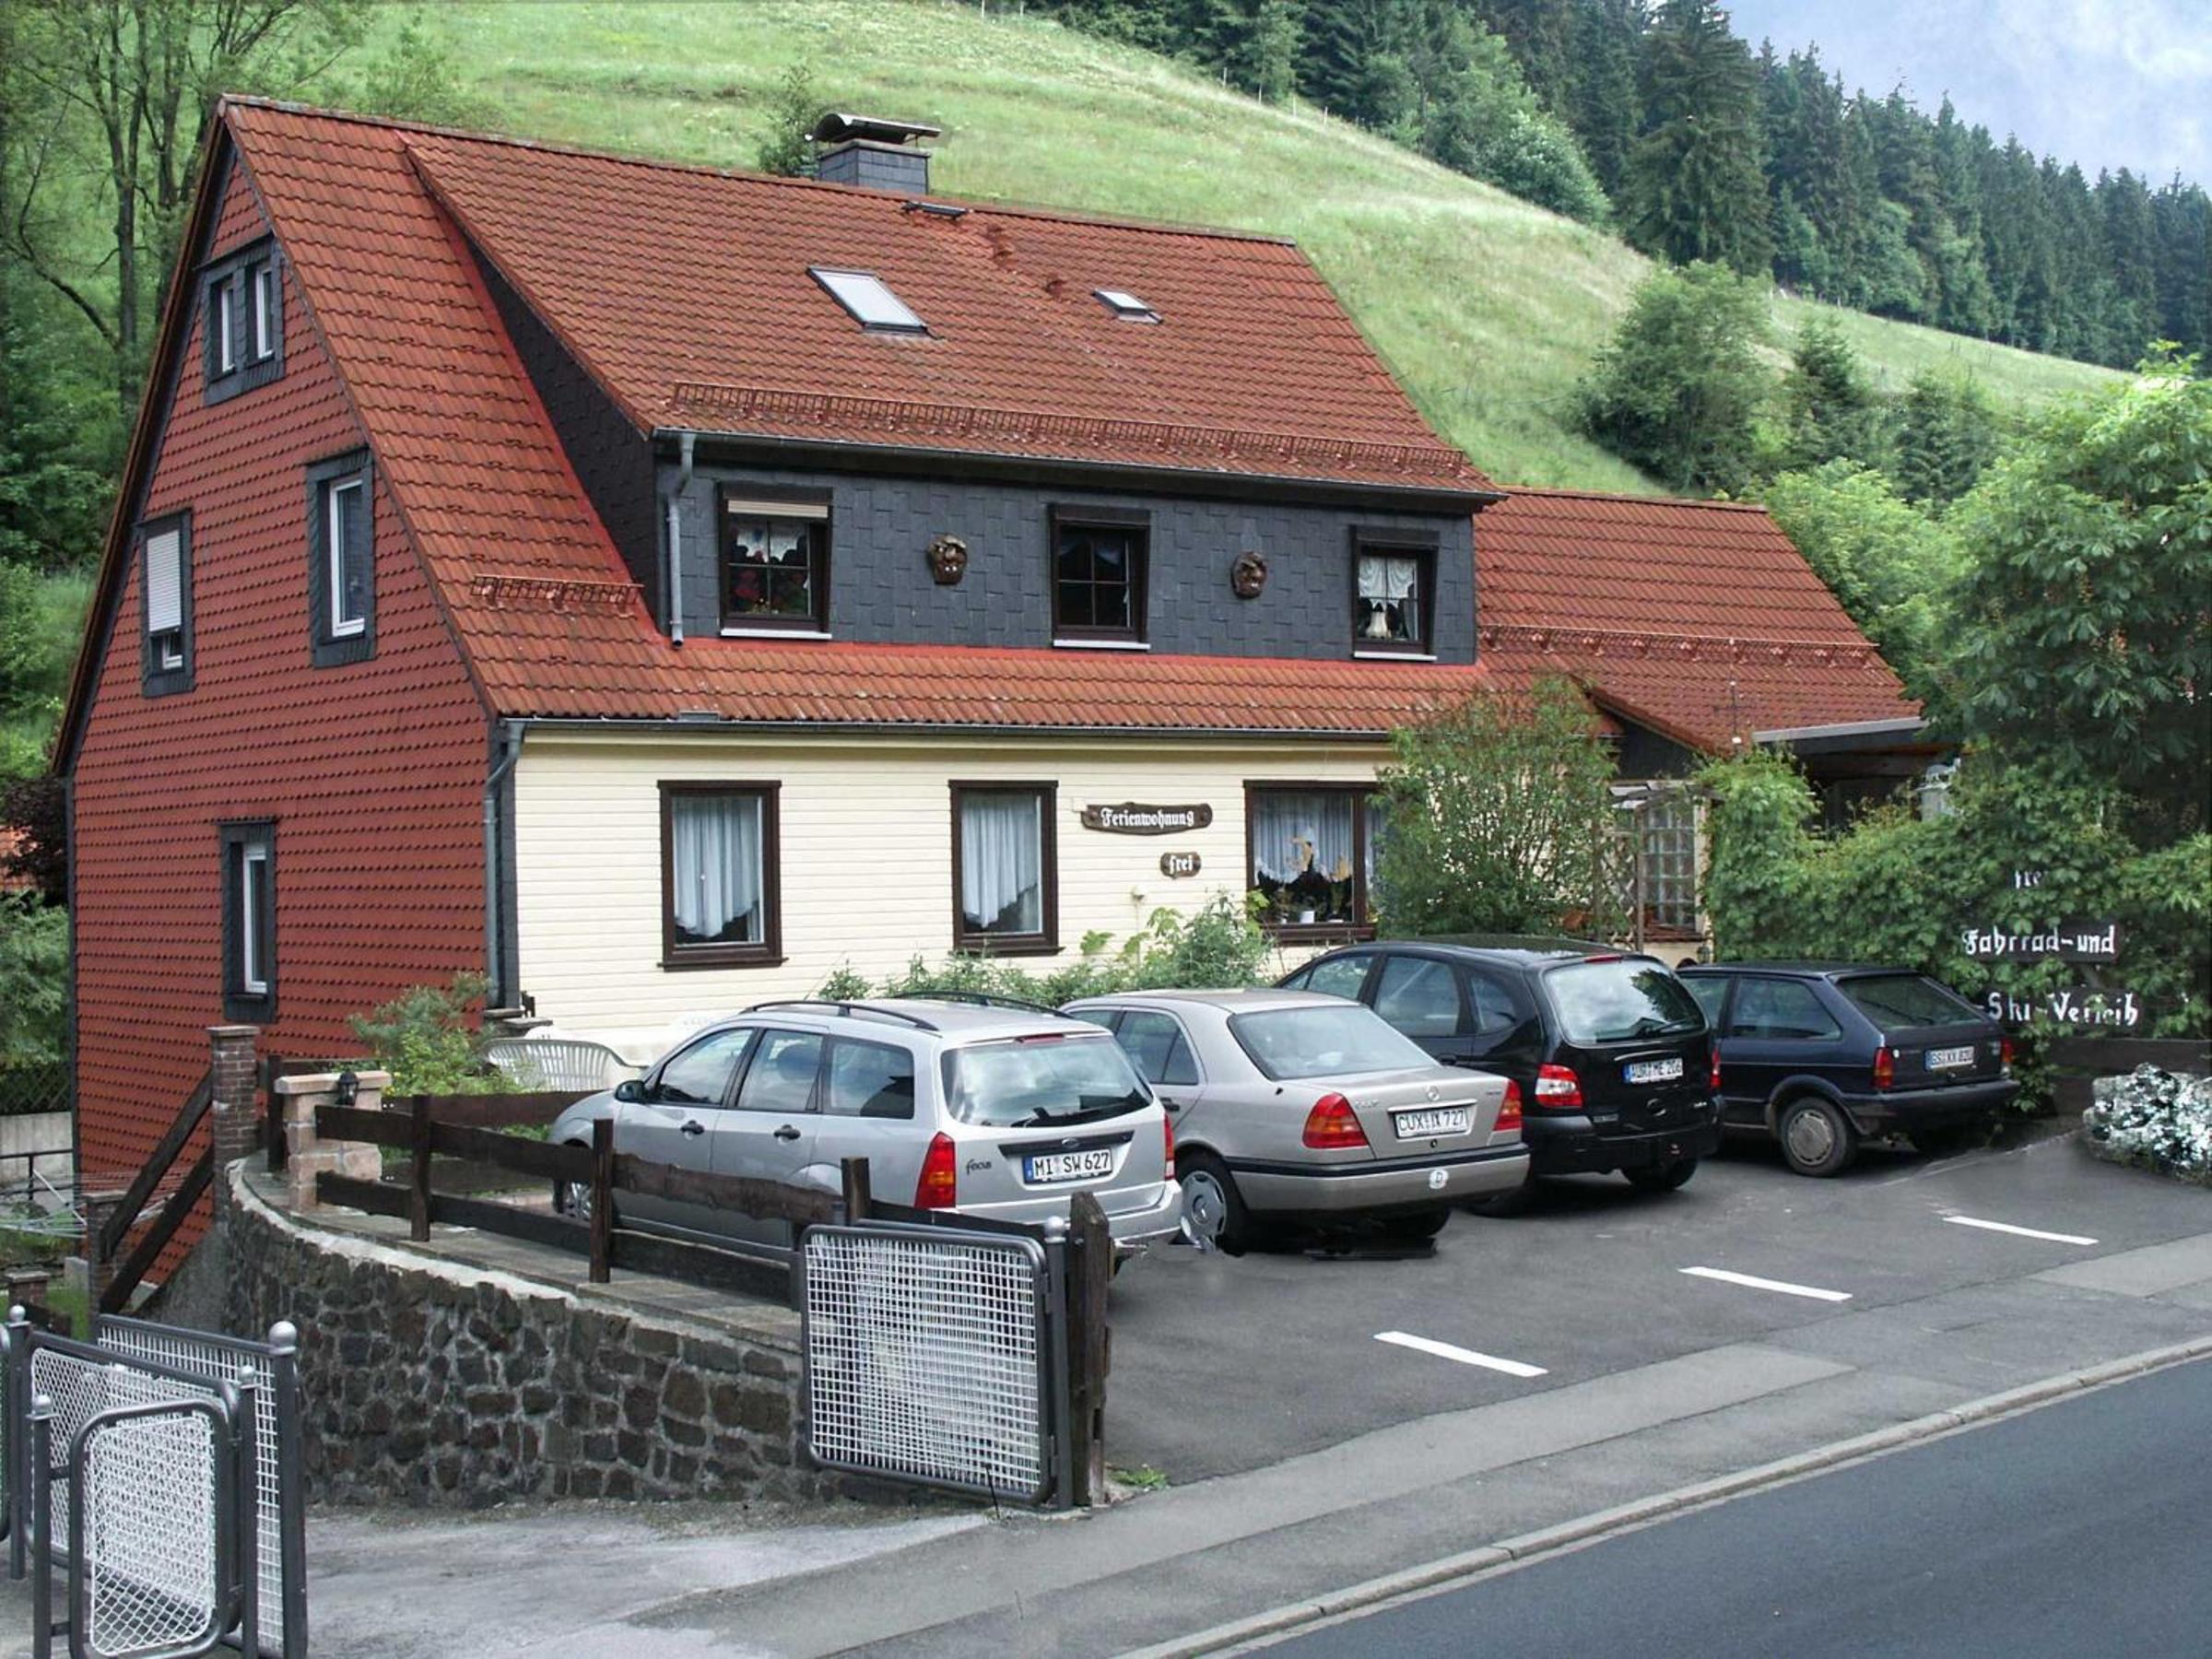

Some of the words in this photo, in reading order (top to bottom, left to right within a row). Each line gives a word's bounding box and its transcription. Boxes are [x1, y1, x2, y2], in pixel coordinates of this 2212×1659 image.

[1100, 807, 1194, 829] Ferienwohnung
[1169, 854, 1194, 875] frei
[1443, 1109, 1465, 1126] 727
[1034, 1158, 1053, 1177] MI
[1063, 1154, 1081, 1173] SW
[1085, 1151, 1110, 1171] 627
